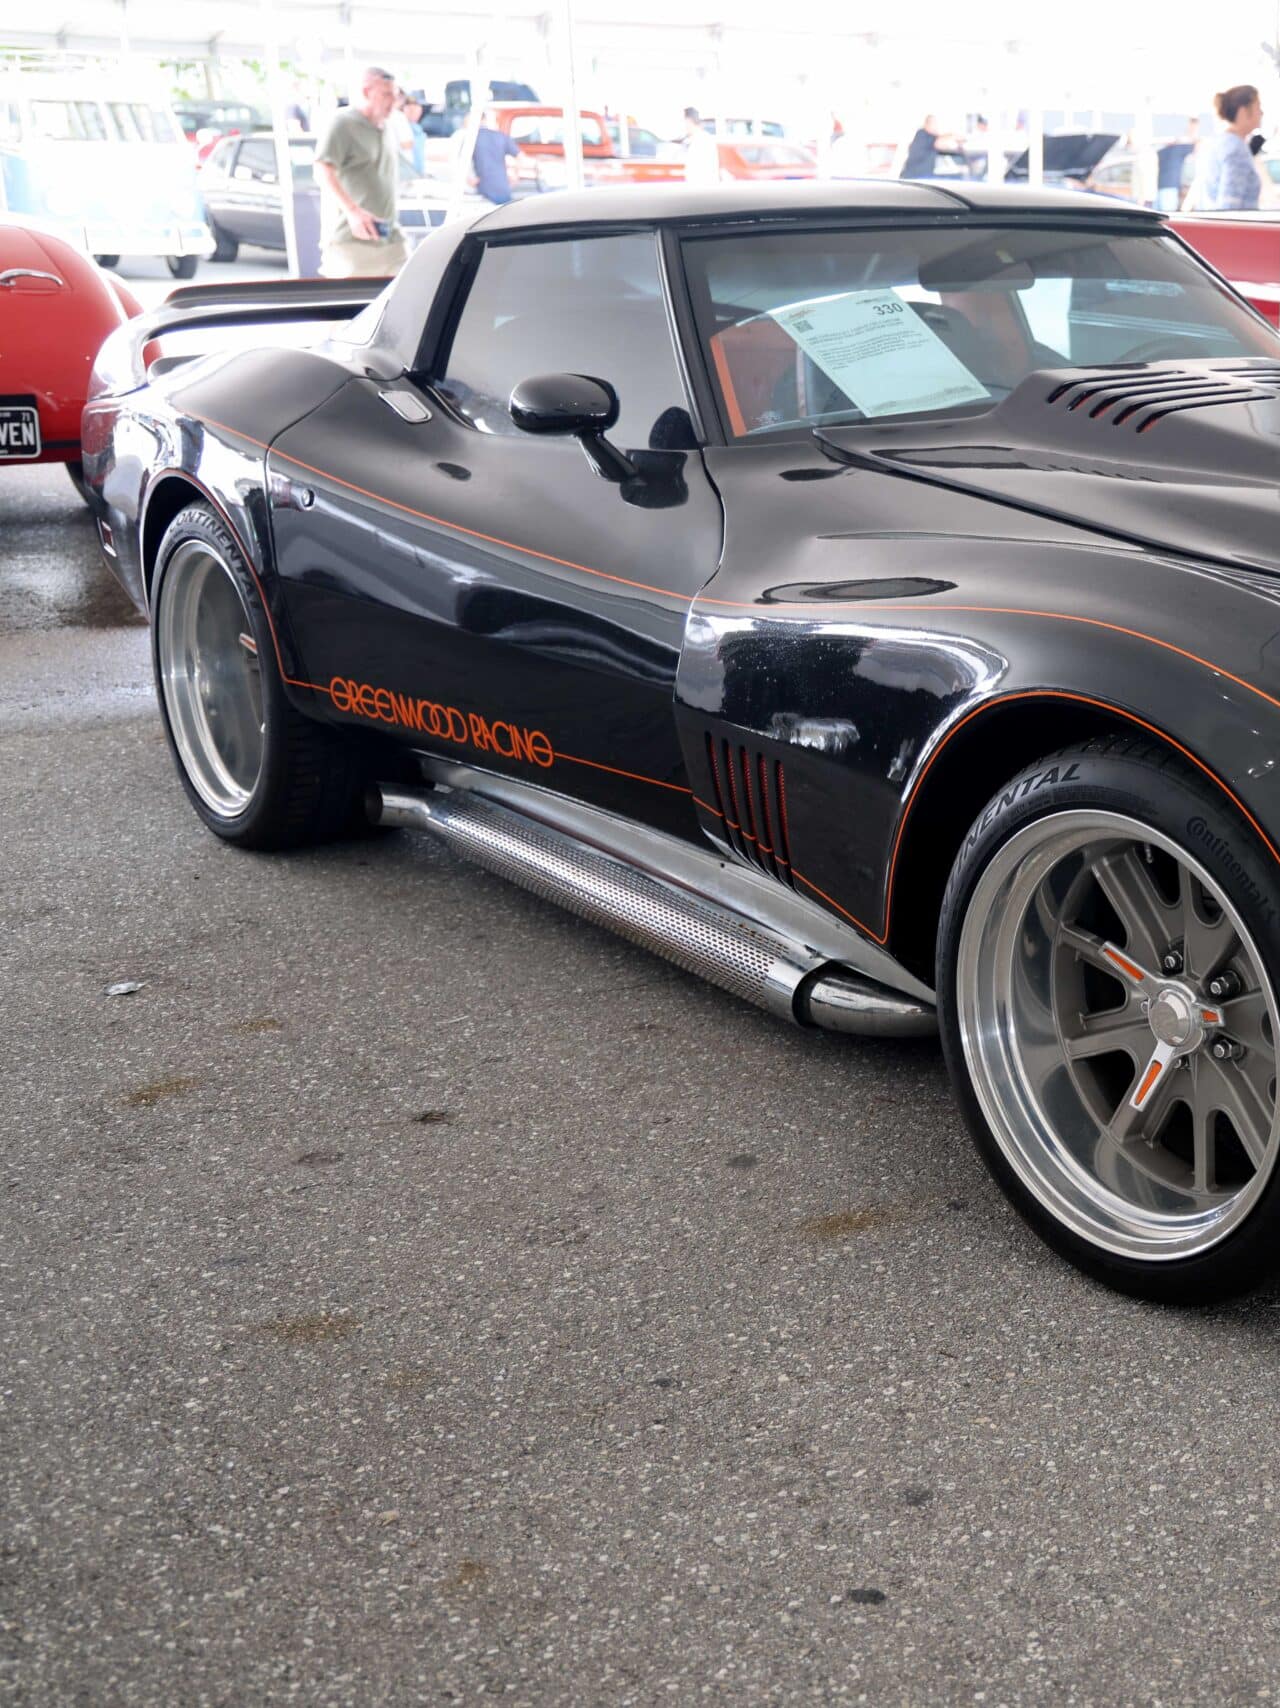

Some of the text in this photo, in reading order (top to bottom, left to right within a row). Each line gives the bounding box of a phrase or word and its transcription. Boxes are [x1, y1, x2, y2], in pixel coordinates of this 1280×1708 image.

[872, 303, 904, 317] 330
[330, 676, 554, 767] GREENWOOD RACING
